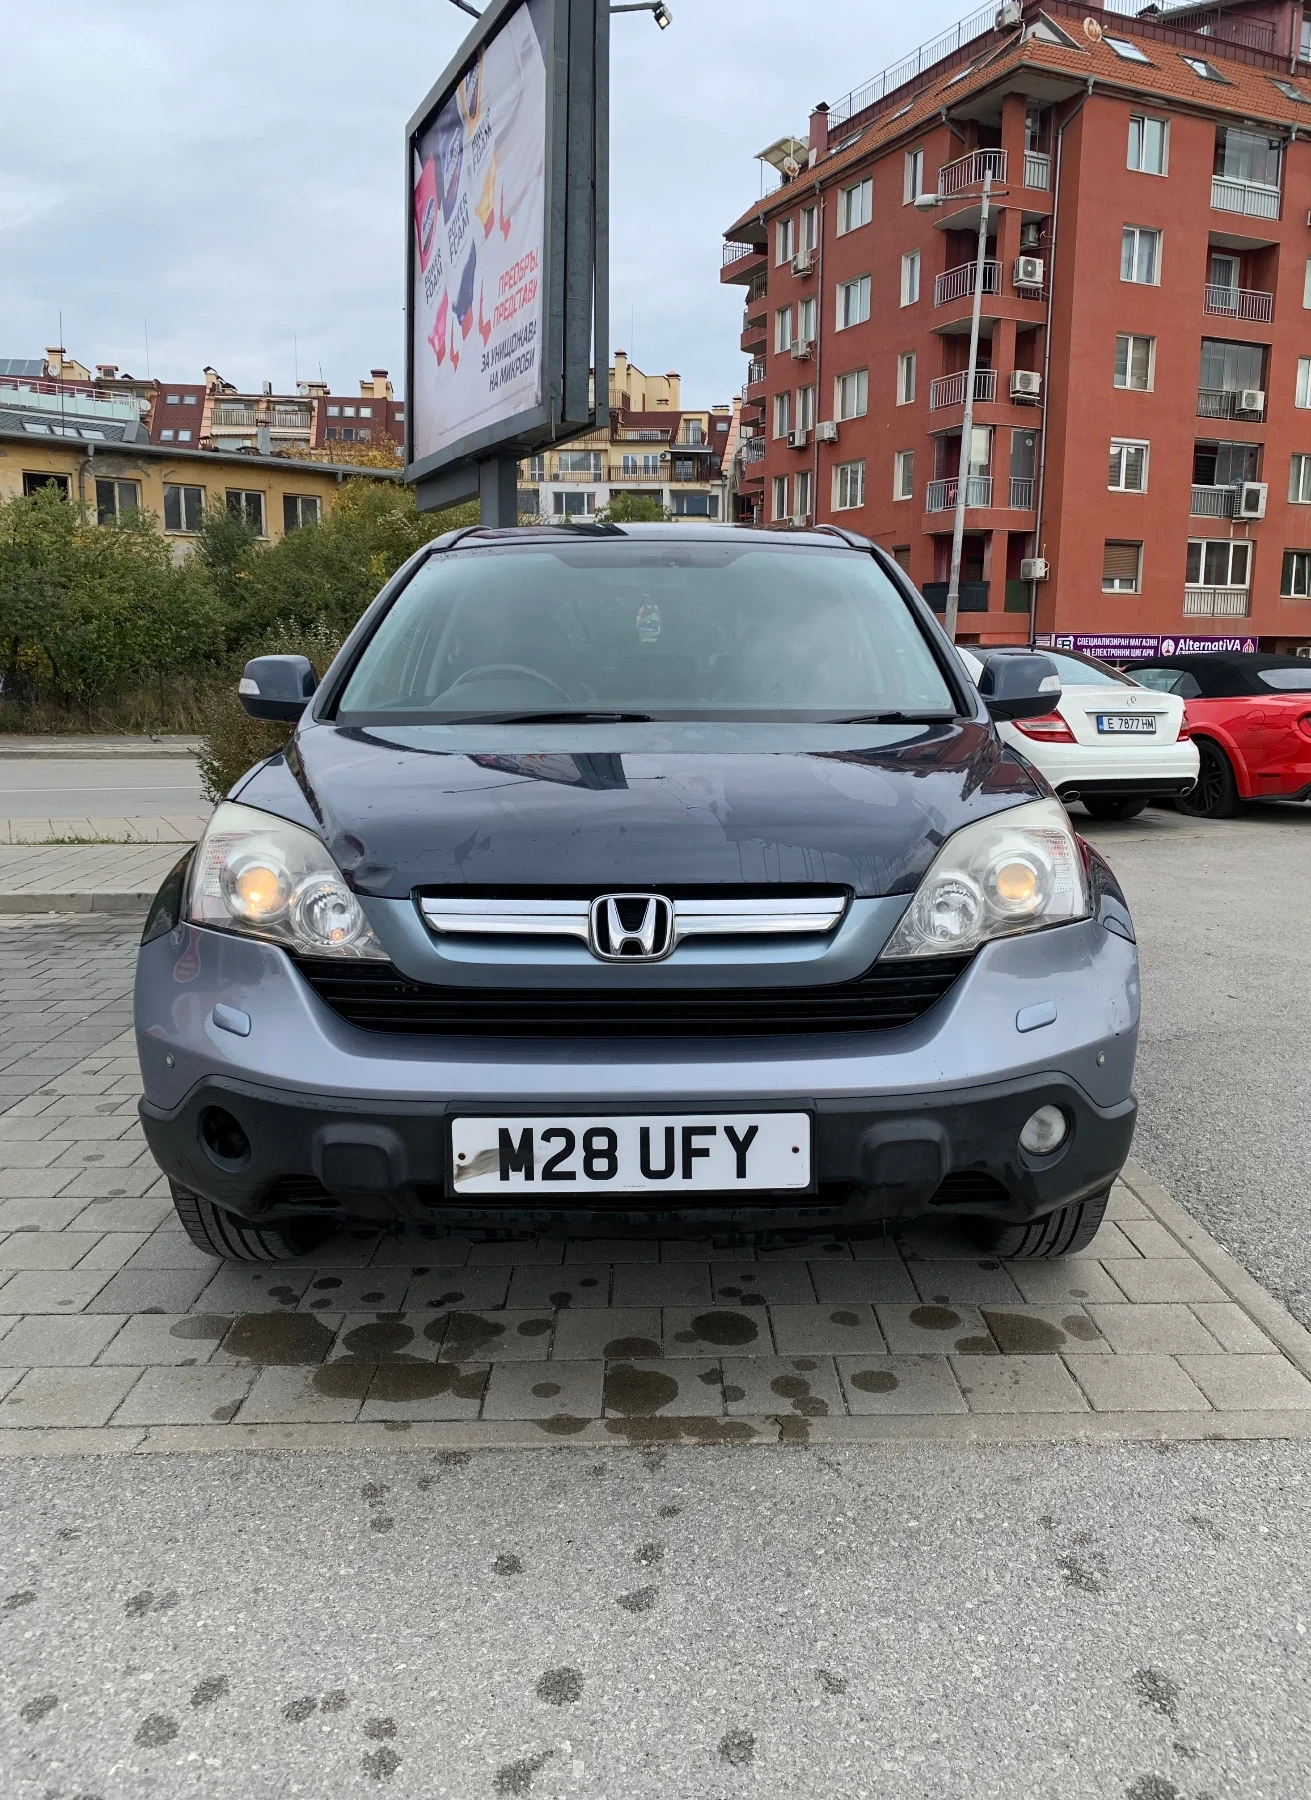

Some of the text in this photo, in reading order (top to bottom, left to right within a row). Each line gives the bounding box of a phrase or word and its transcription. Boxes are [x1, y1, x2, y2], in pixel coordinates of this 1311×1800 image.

[472, 123, 493, 173] FOAM
[448, 192, 468, 240] POWER
[449, 211, 470, 264] FOAM
[424, 248, 442, 288] POWER
[425, 265, 443, 305] FOAM
[481, 348, 490, 373] ЗА
[489, 346, 536, 393] НА МИКРОБИ
[1077, 637, 1129, 647] СПЕЦИАЛИЗИРАН
[1130, 638, 1158, 647] МАГАЗИН
[1082, 648, 1154, 657] ЗА ЕЛЕКТРОННИ ЦИГАРИ
[1177, 638, 1241, 651] AlternatiVA
[1107, 718, 1114, 729] E
[1118, 718, 1140, 729] 7877
[1141, 718, 1154, 729] HM
[498, 1125, 759, 1181] M28 UFY
